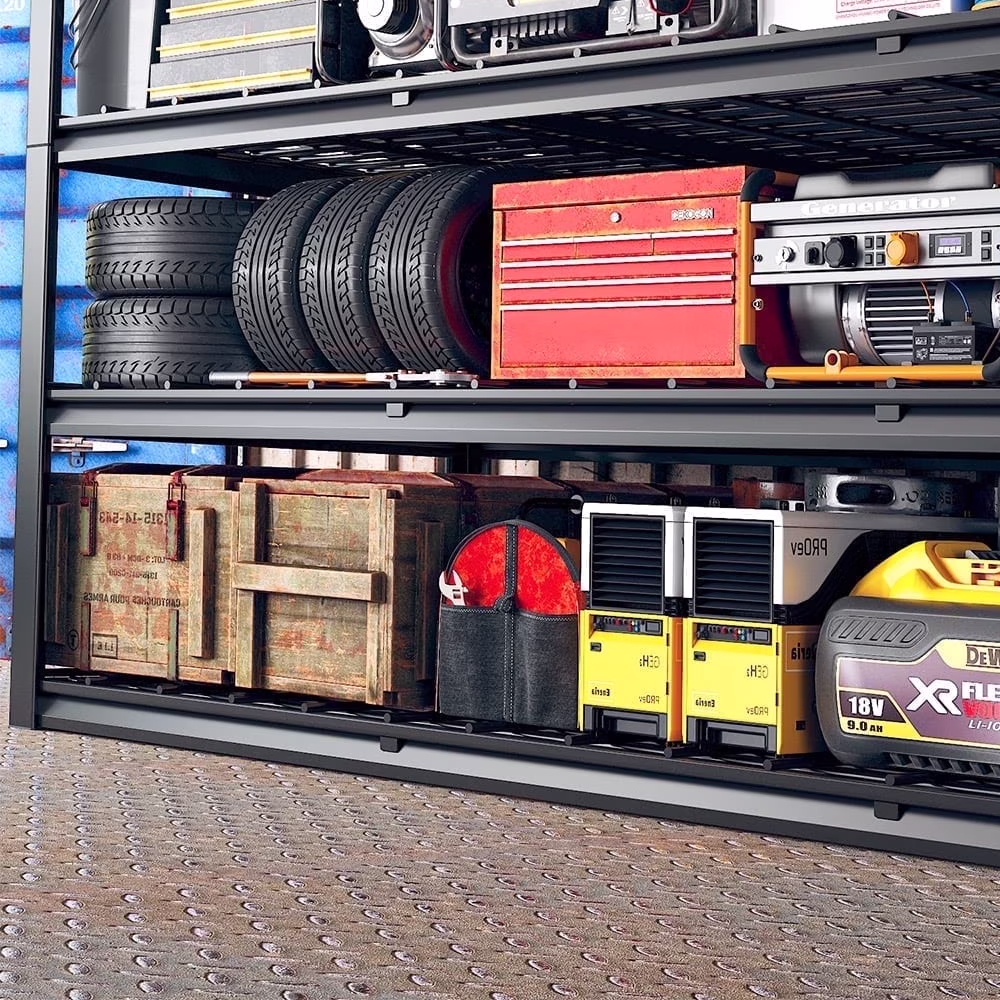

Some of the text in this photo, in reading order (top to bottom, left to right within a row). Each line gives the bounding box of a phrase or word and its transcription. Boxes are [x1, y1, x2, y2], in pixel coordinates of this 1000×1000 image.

[801, 195, 957, 218] Generator
[848, 696, 885, 718] 18V
[906, 676, 963, 716] XR
[847, 719, 868, 733] 9.0
